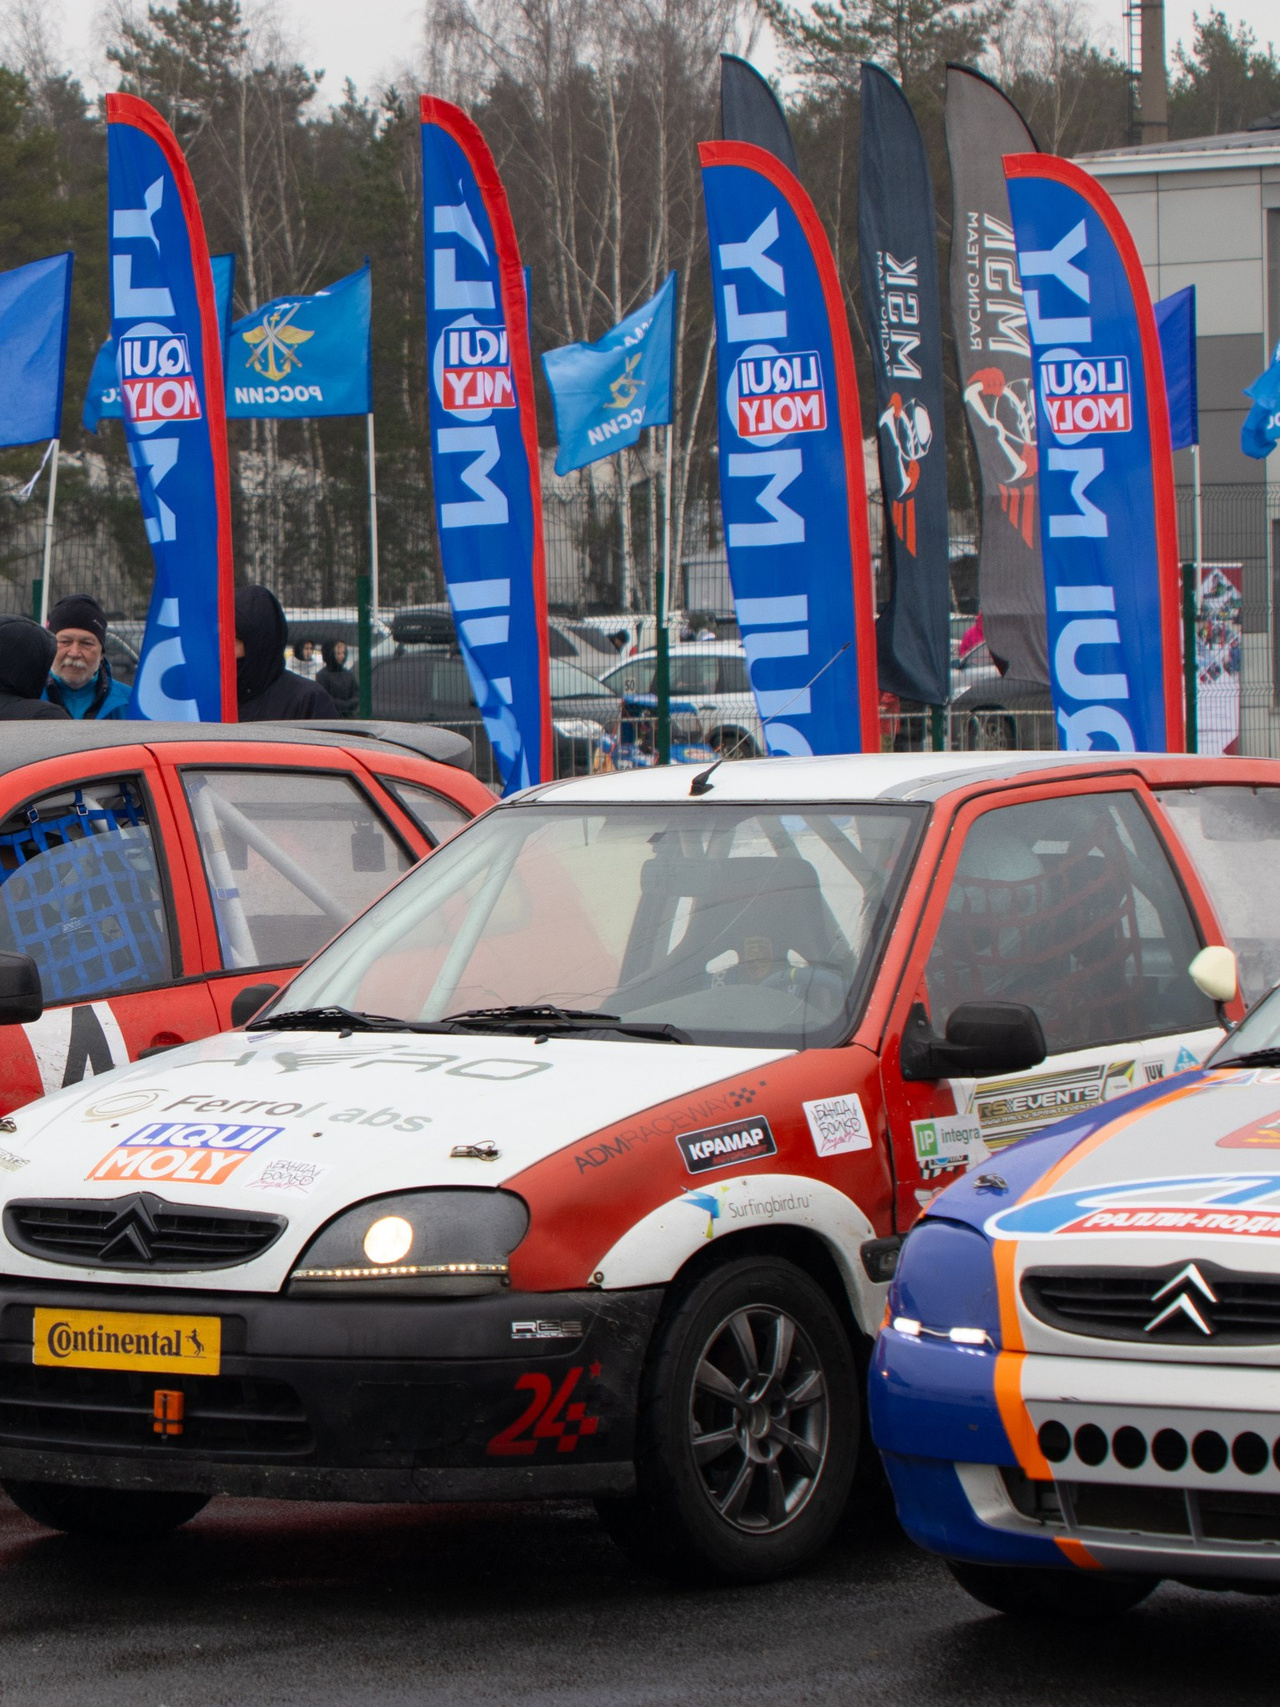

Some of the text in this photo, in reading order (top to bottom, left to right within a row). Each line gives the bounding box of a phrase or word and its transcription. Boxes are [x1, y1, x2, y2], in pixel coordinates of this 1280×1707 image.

[1012, 1085, 1099, 1113] EVENTS
[129, 1124, 272, 1150] LIQUI
[573, 1093, 735, 1175] ADMRACEWAY
[688, 1127, 765, 1161] КРАМАР
[940, 1126, 981, 1145] integra
[99, 1150, 244, 1181] MOLY
[728, 1193, 810, 1219] Surfingbird.ru
[48, 1321, 183, 1358] Continental
[486, 1366, 599, 1455] 24
